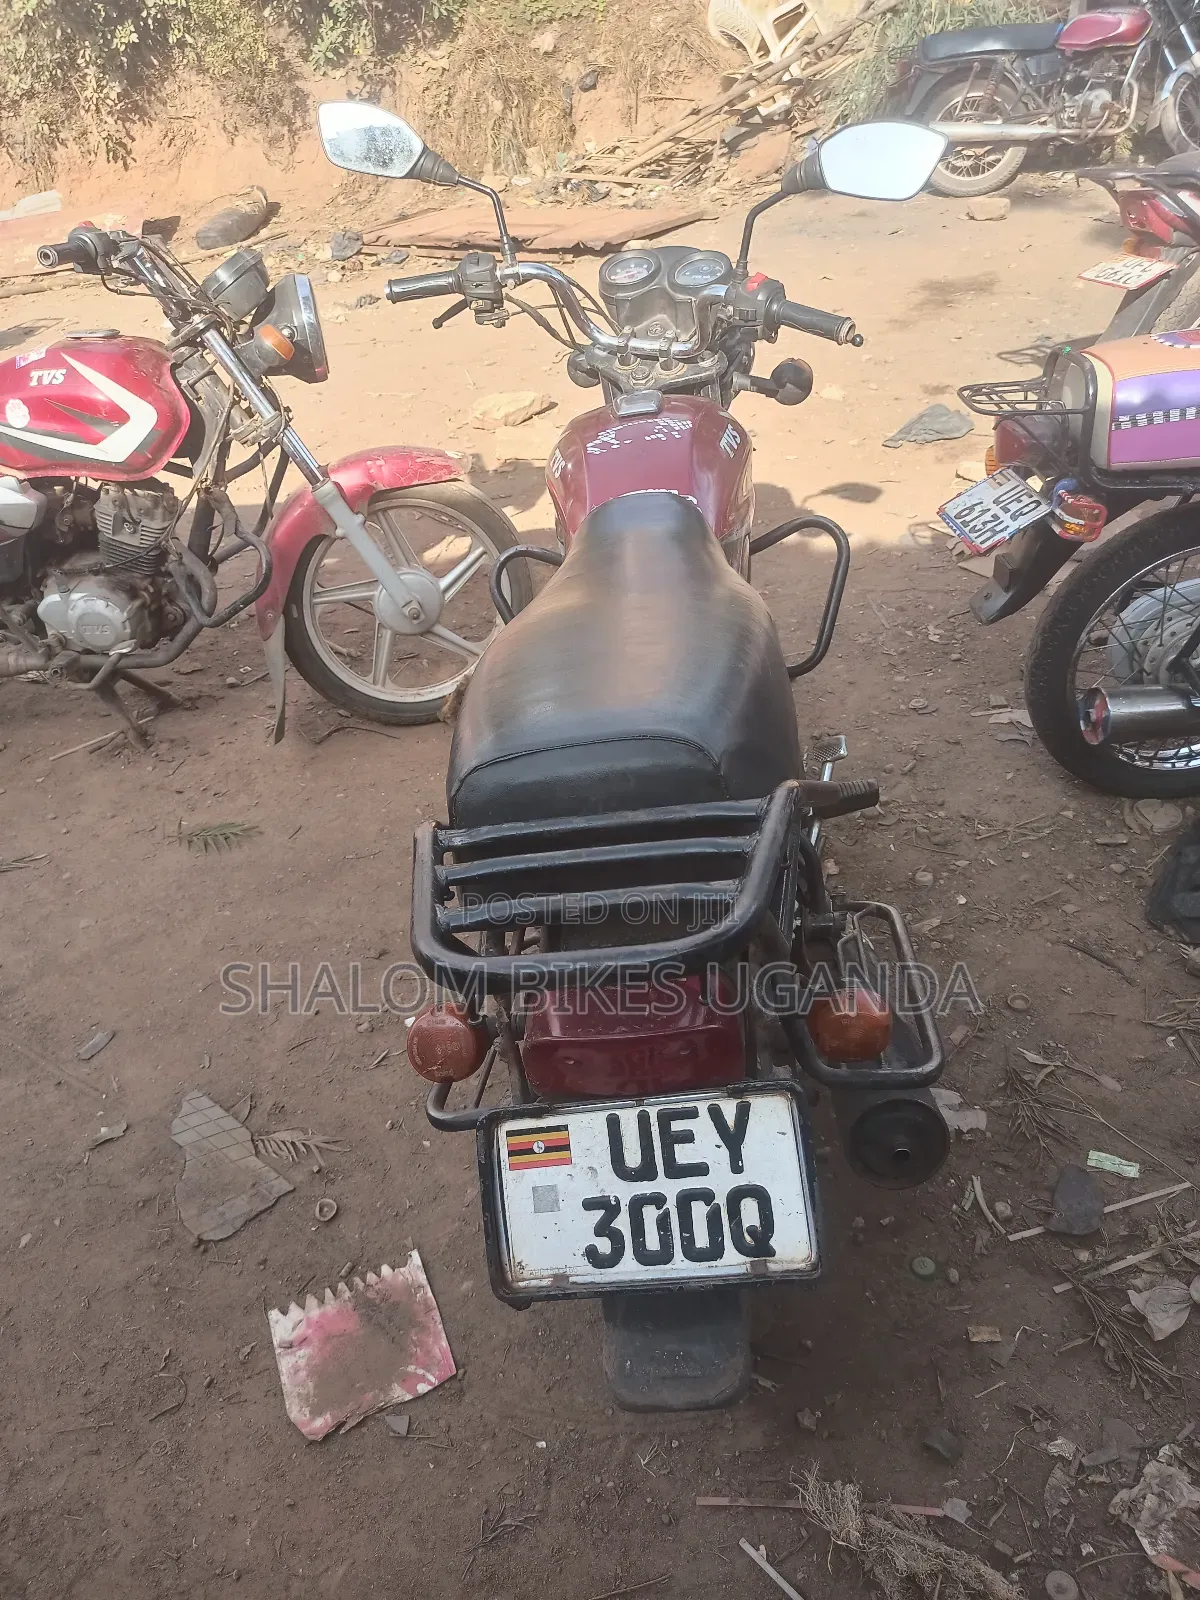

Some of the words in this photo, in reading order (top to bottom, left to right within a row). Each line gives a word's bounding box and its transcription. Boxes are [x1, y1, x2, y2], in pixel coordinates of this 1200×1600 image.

[29, 369, 67, 387] TVS
[719, 423, 742, 459] TVS
[549, 447, 566, 479] TVS
[992, 484, 1042, 522] UEQ
[953, 501, 1010, 545] 613H
[81, 624, 111, 636] TVS
[606, 1101, 751, 1183] UEY
[581, 1184, 777, 1269] 300Q
